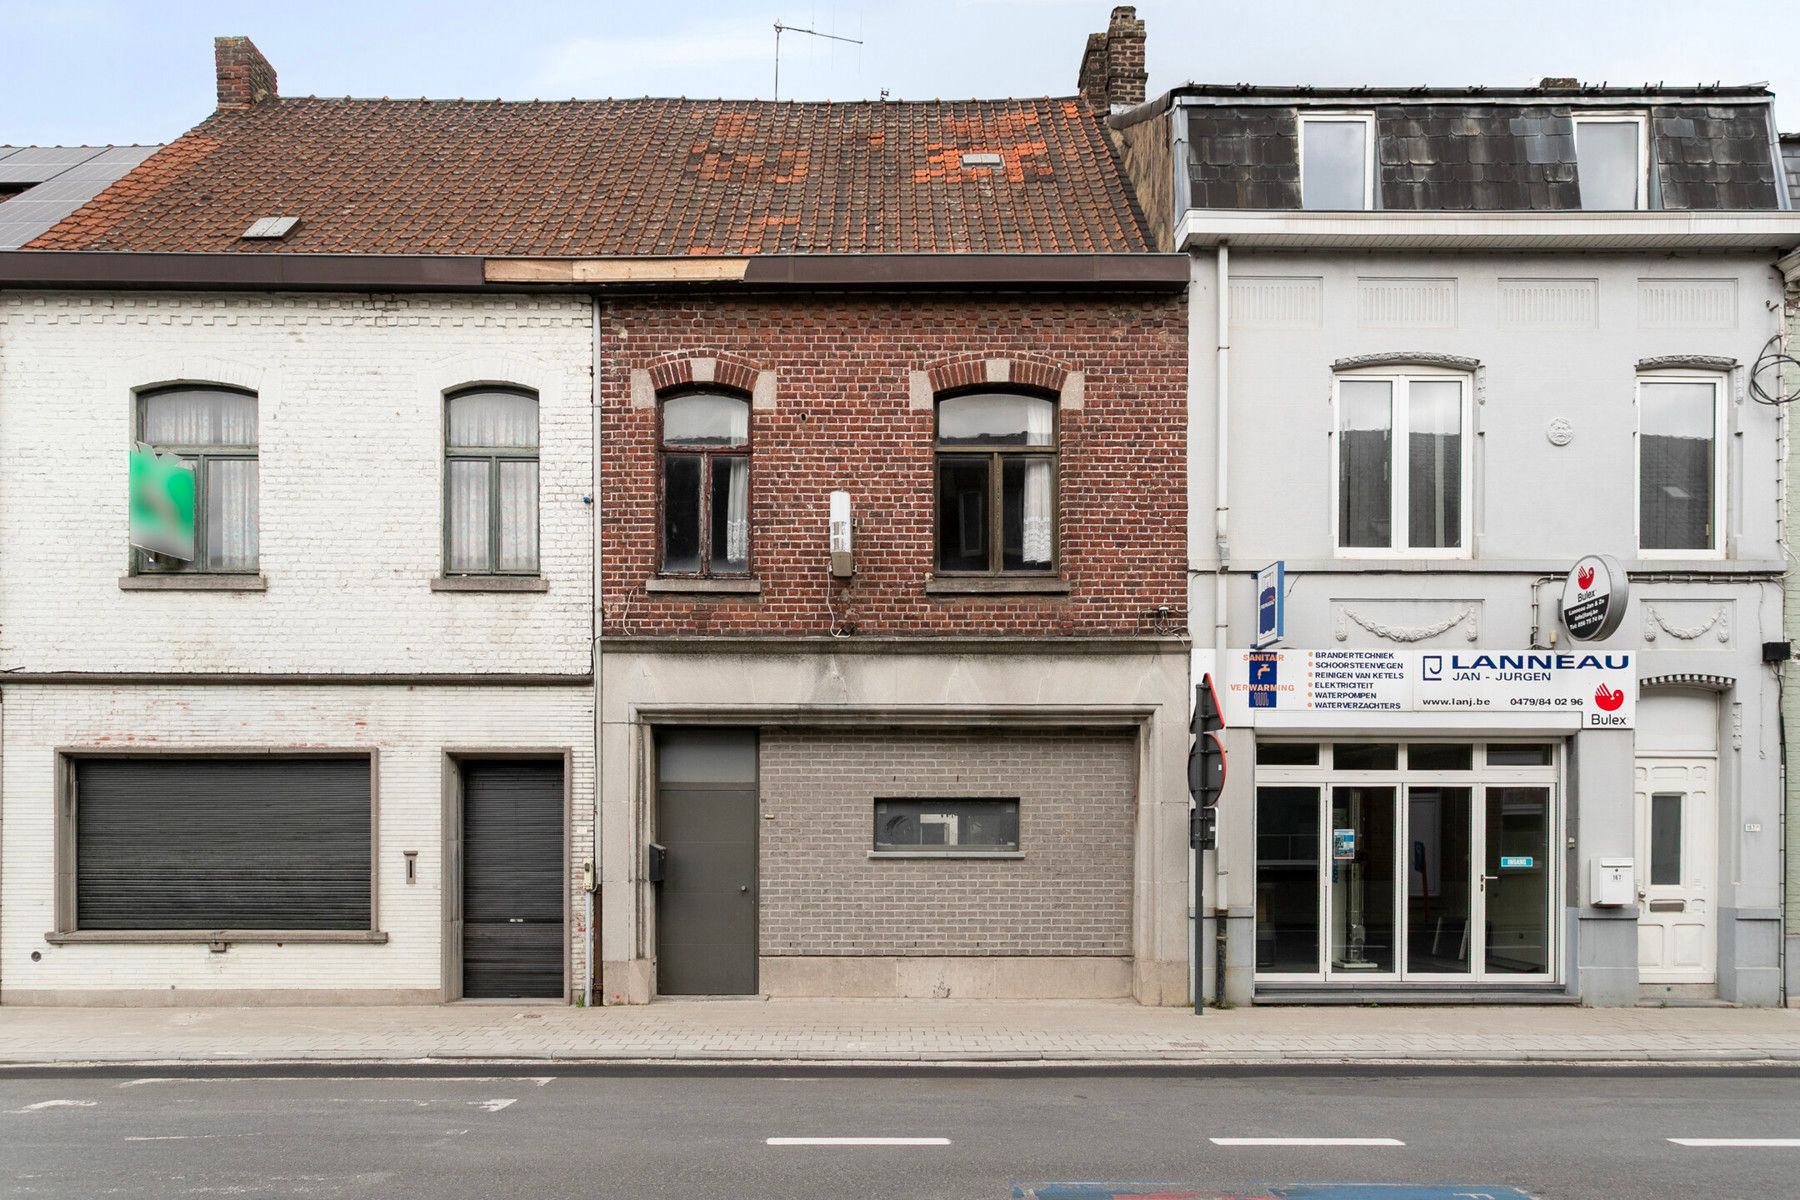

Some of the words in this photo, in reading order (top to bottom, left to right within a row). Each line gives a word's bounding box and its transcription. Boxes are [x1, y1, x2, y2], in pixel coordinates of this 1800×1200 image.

[1577, 590, 1596, 602] Bulex
[1315, 651, 1394, 659] BRANDERTECHNIEK
[1452, 655, 1629, 670] LANNEAU
[1452, 672, 1481, 681] JAN
[1495, 672, 1551, 681] JURGEN
[1230, 683, 1295, 692] VERWARMING
[1422, 698, 1491, 707] www.lanj.be
[1510, 698, 1552, 706] 0479/84
[1554, 698, 1567, 706] 02
[1570, 698, 1584, 706] 96
[1591, 713, 1627, 725] Bulex
